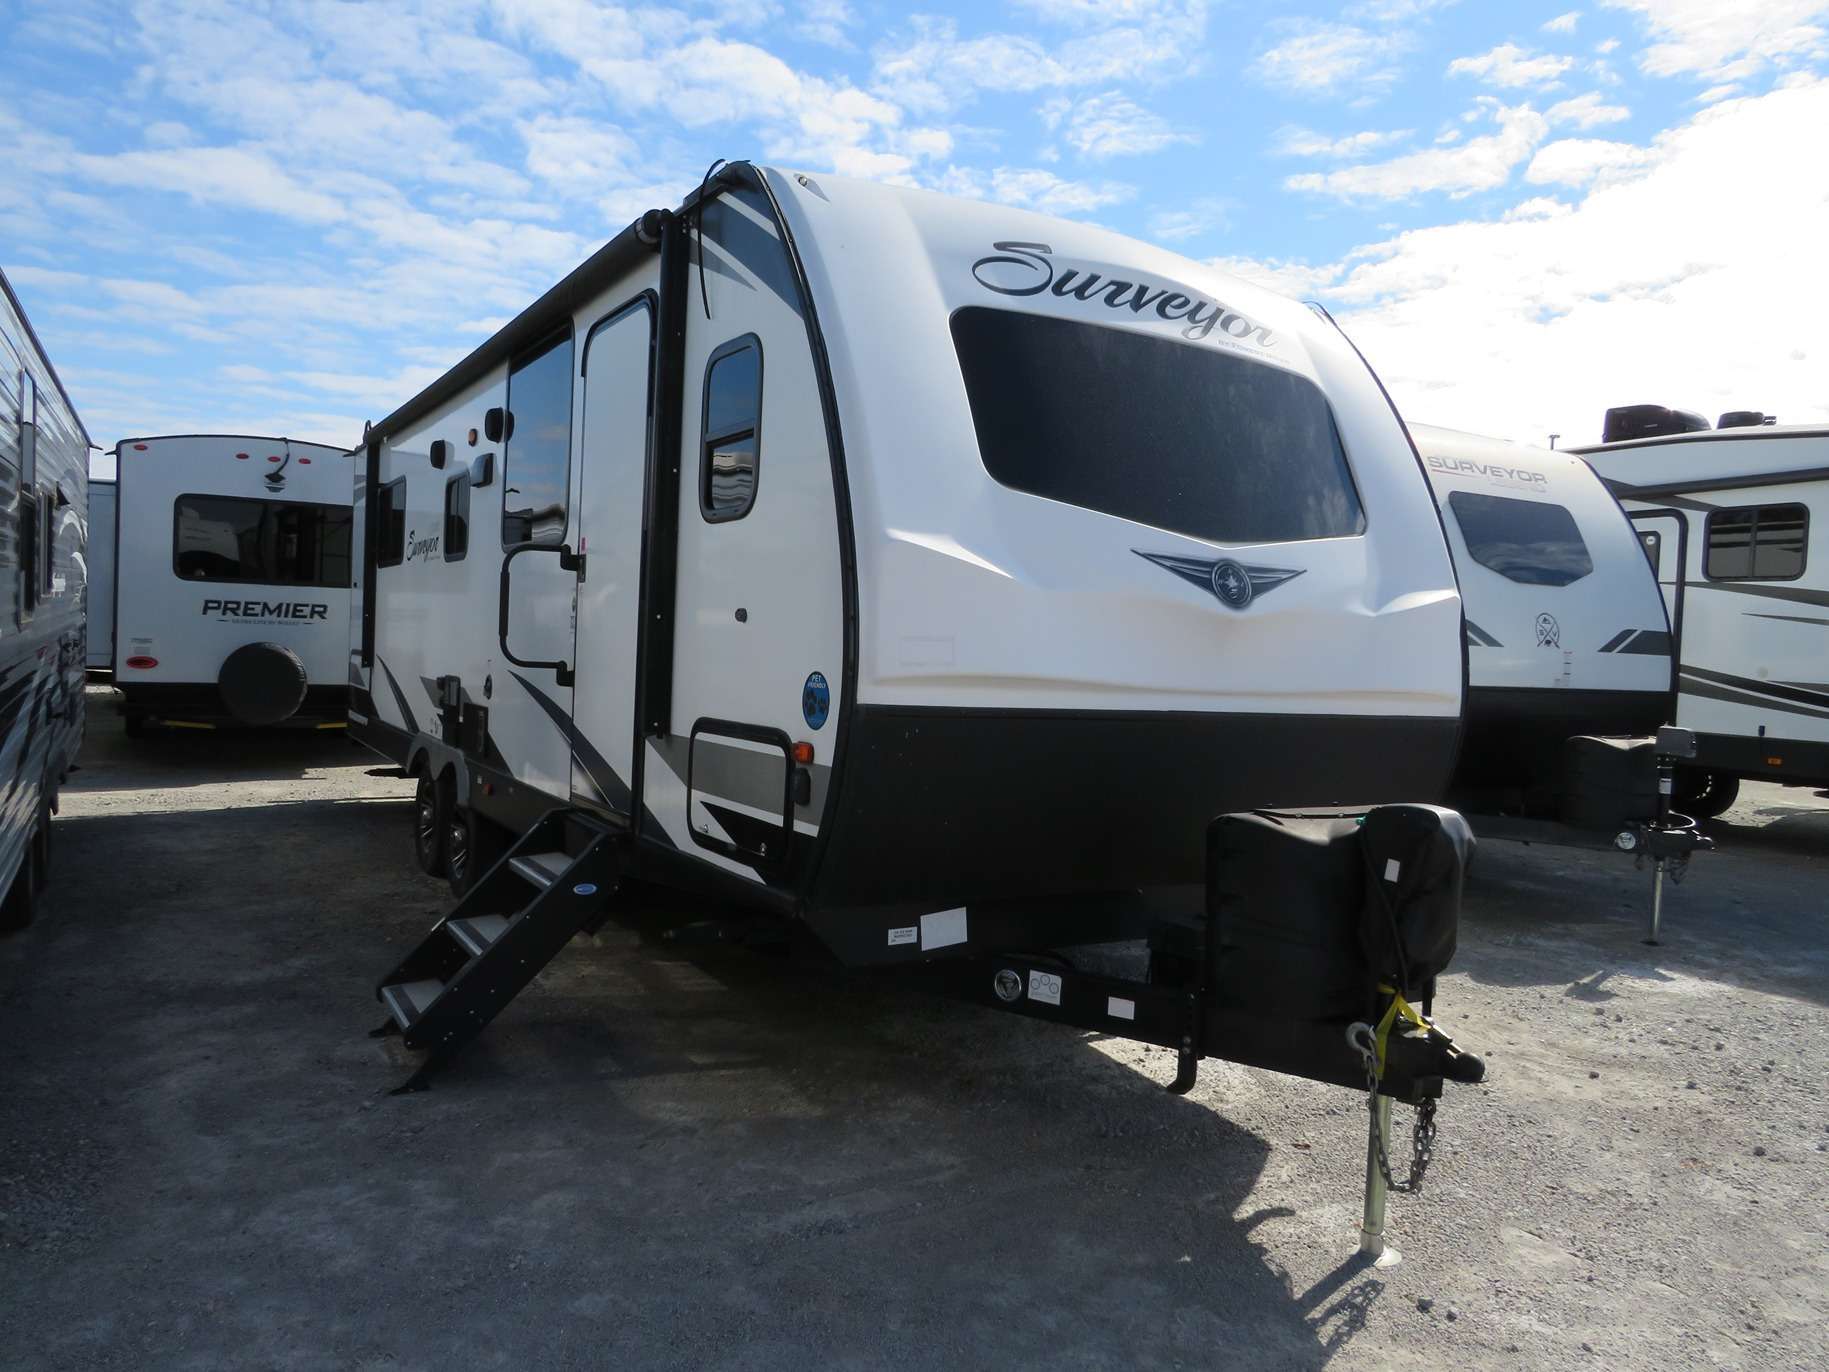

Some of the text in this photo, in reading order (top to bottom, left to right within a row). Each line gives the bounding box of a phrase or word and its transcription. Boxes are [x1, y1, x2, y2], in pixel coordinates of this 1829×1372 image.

[972, 241, 1278, 348] Surveyor
[1427, 456, 1548, 485] SURVEYOR
[406, 530, 440, 562] Surveyor
[202, 600, 328, 619] PREMIER
